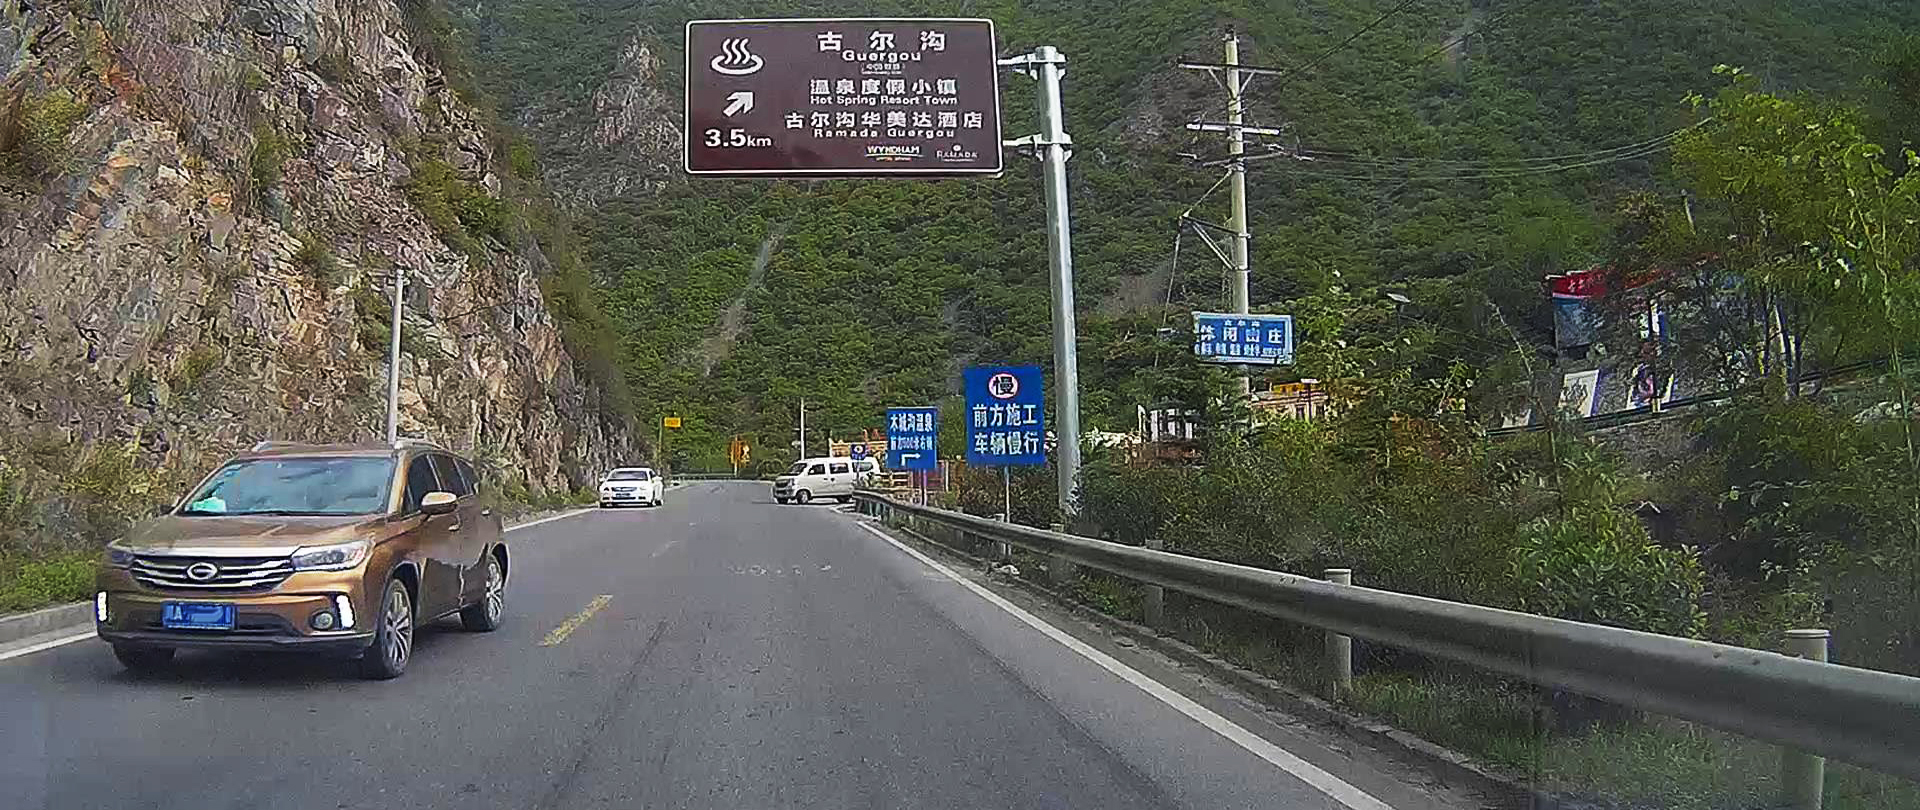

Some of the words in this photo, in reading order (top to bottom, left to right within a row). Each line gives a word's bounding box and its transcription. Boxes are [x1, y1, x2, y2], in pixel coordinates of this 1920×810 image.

[817, 31, 946, 51] 古尔沟
[842, 50, 921, 62] Guergou
[810, 79, 957, 95] 温泉度假小镇
[810, 95, 833, 105] Hot
[836, 95, 877, 106] Spring
[880, 95, 920, 105] Resort
[923, 95, 958, 105] Town
[785, 111, 982, 128] 古尔沟华美达酒店
[705, 129, 772, 148] 3.5km
[814, 128, 878, 138] Ramada
[887, 128, 955, 139] Guergou
[993, 376, 1014, 395] 慢
[972, 403, 1038, 427] 前方施工
[974, 431, 1040, 455] 车辆慢行
